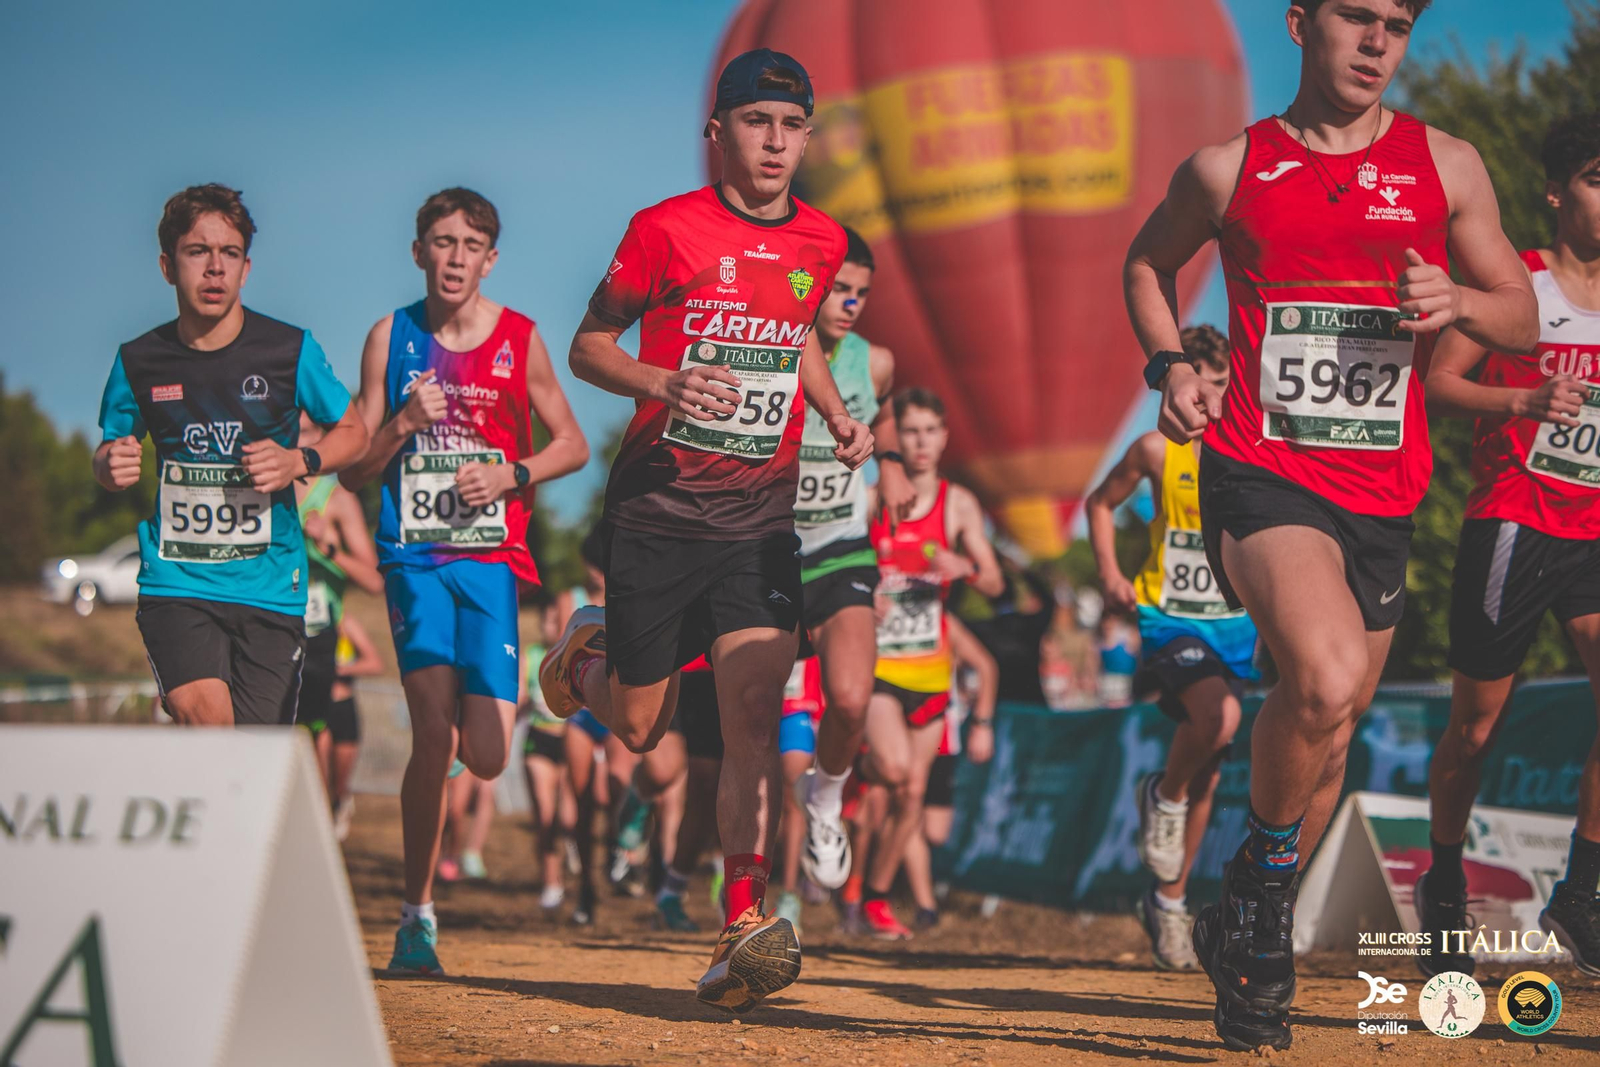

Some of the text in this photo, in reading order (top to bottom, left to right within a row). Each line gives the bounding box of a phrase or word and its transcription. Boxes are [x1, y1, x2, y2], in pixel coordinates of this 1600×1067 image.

[1368, 205, 1413, 216] Fundación
[743, 250, 781, 260] TEAMERGY
[685, 298, 747, 311] ATLETISMO
[1311, 308, 1382, 330] ITÁLICA
[724, 348, 774, 365] ITÁLICA
[1275, 357, 1401, 408] 5962
[1548, 422, 1600, 458] 80
[188, 468, 241, 482] ITÁLICA
[172, 501, 262, 535] 5995
[1172, 564, 1221, 593] 80
[118, 796, 206, 847] DE
[0, 911, 127, 1067] A
